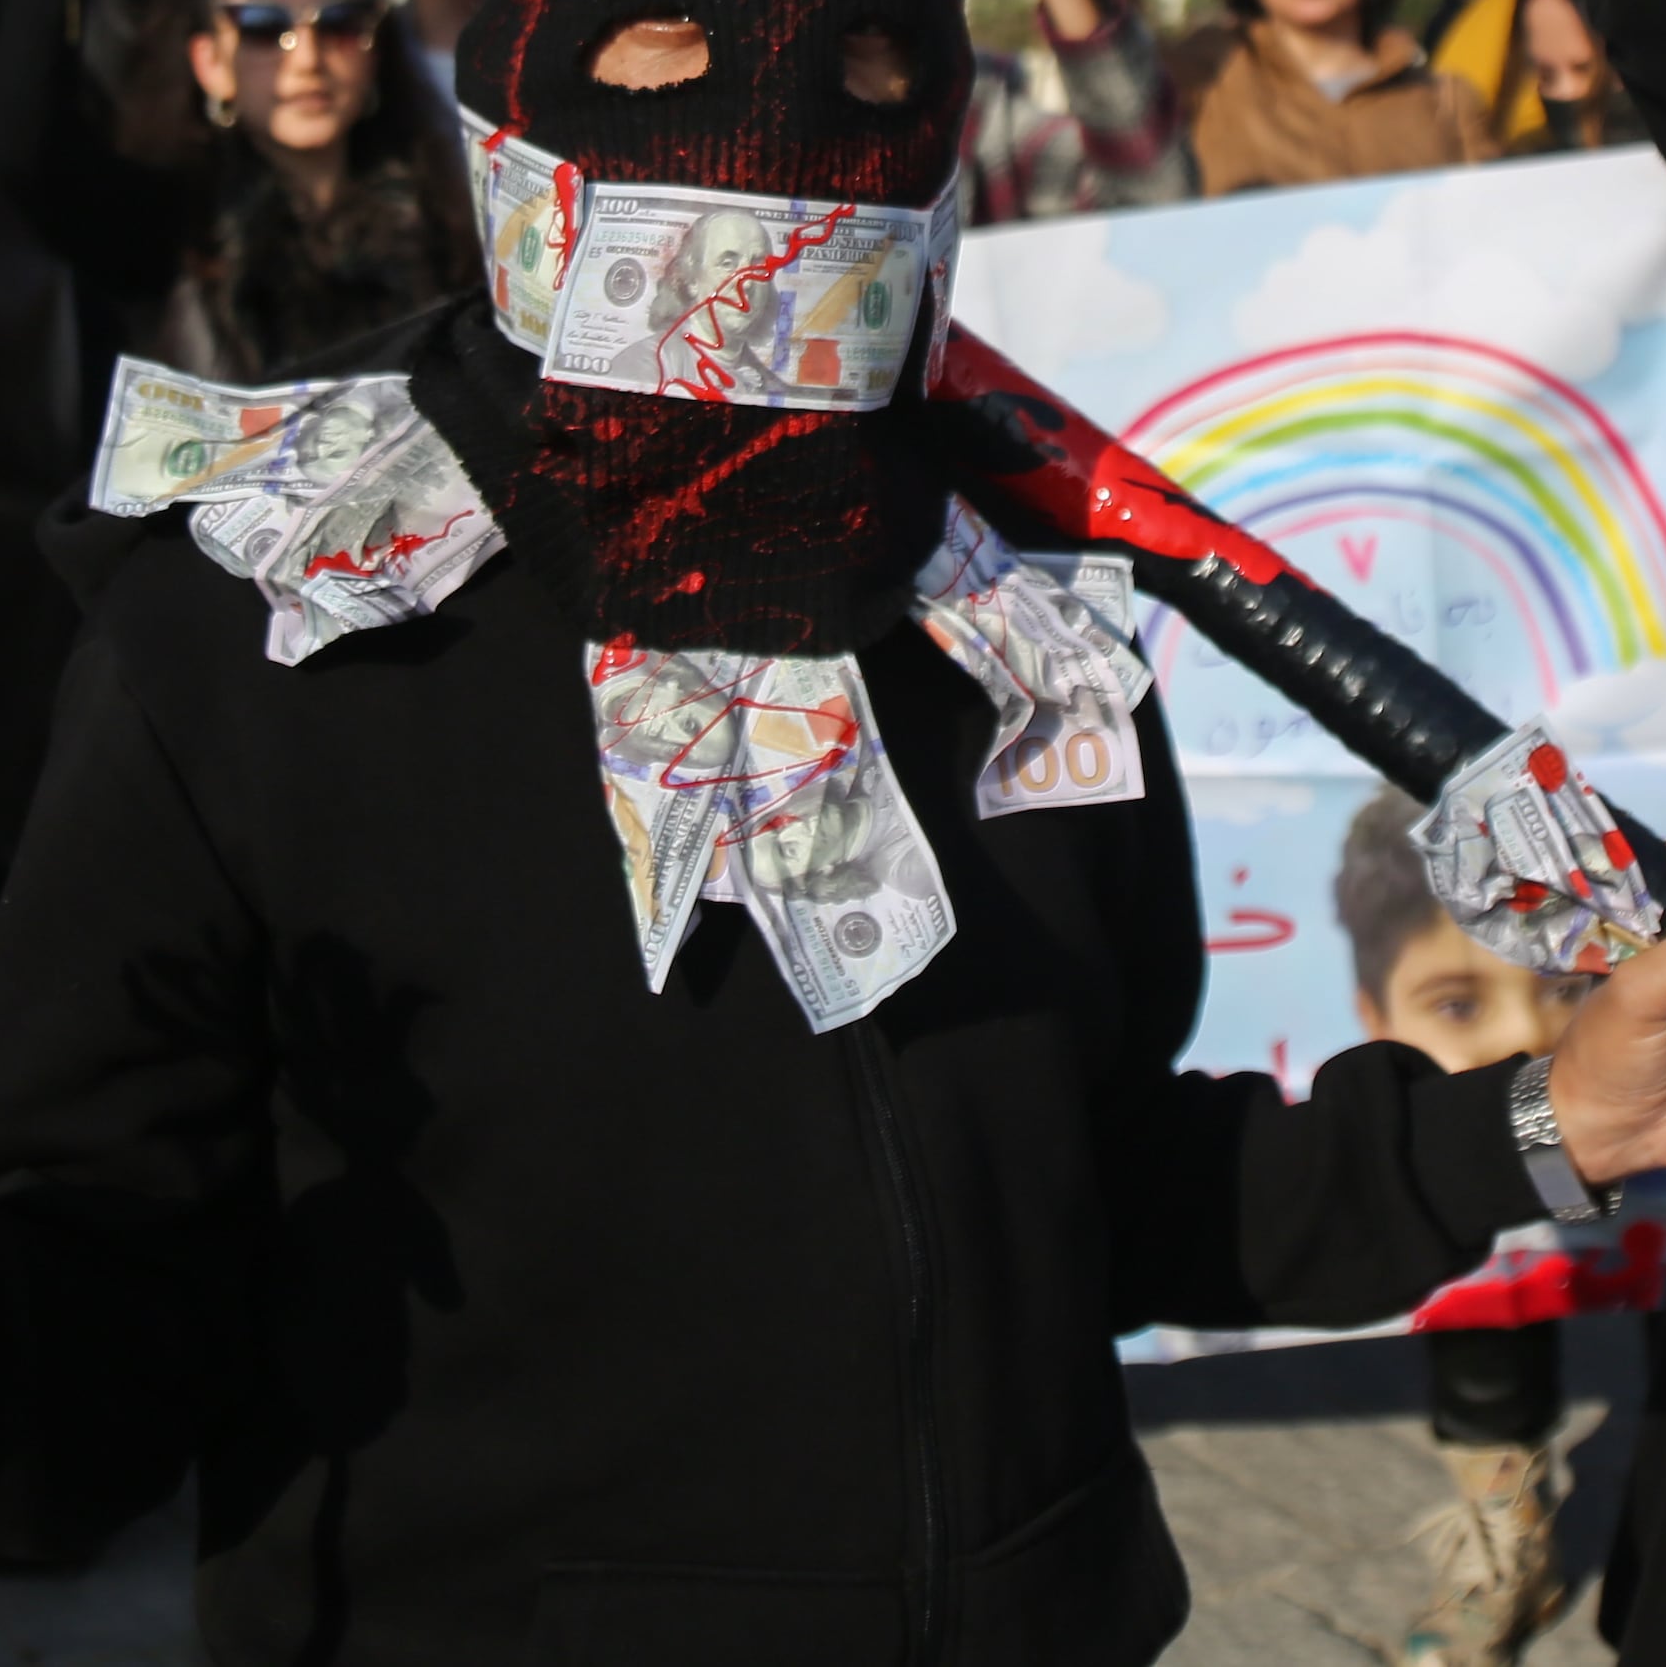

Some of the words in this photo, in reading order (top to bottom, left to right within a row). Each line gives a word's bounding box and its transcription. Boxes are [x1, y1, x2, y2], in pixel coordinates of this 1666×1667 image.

[596, 198, 639, 216] 100
[562, 353, 612, 375] 100
[993, 730, 1113, 799] 100
